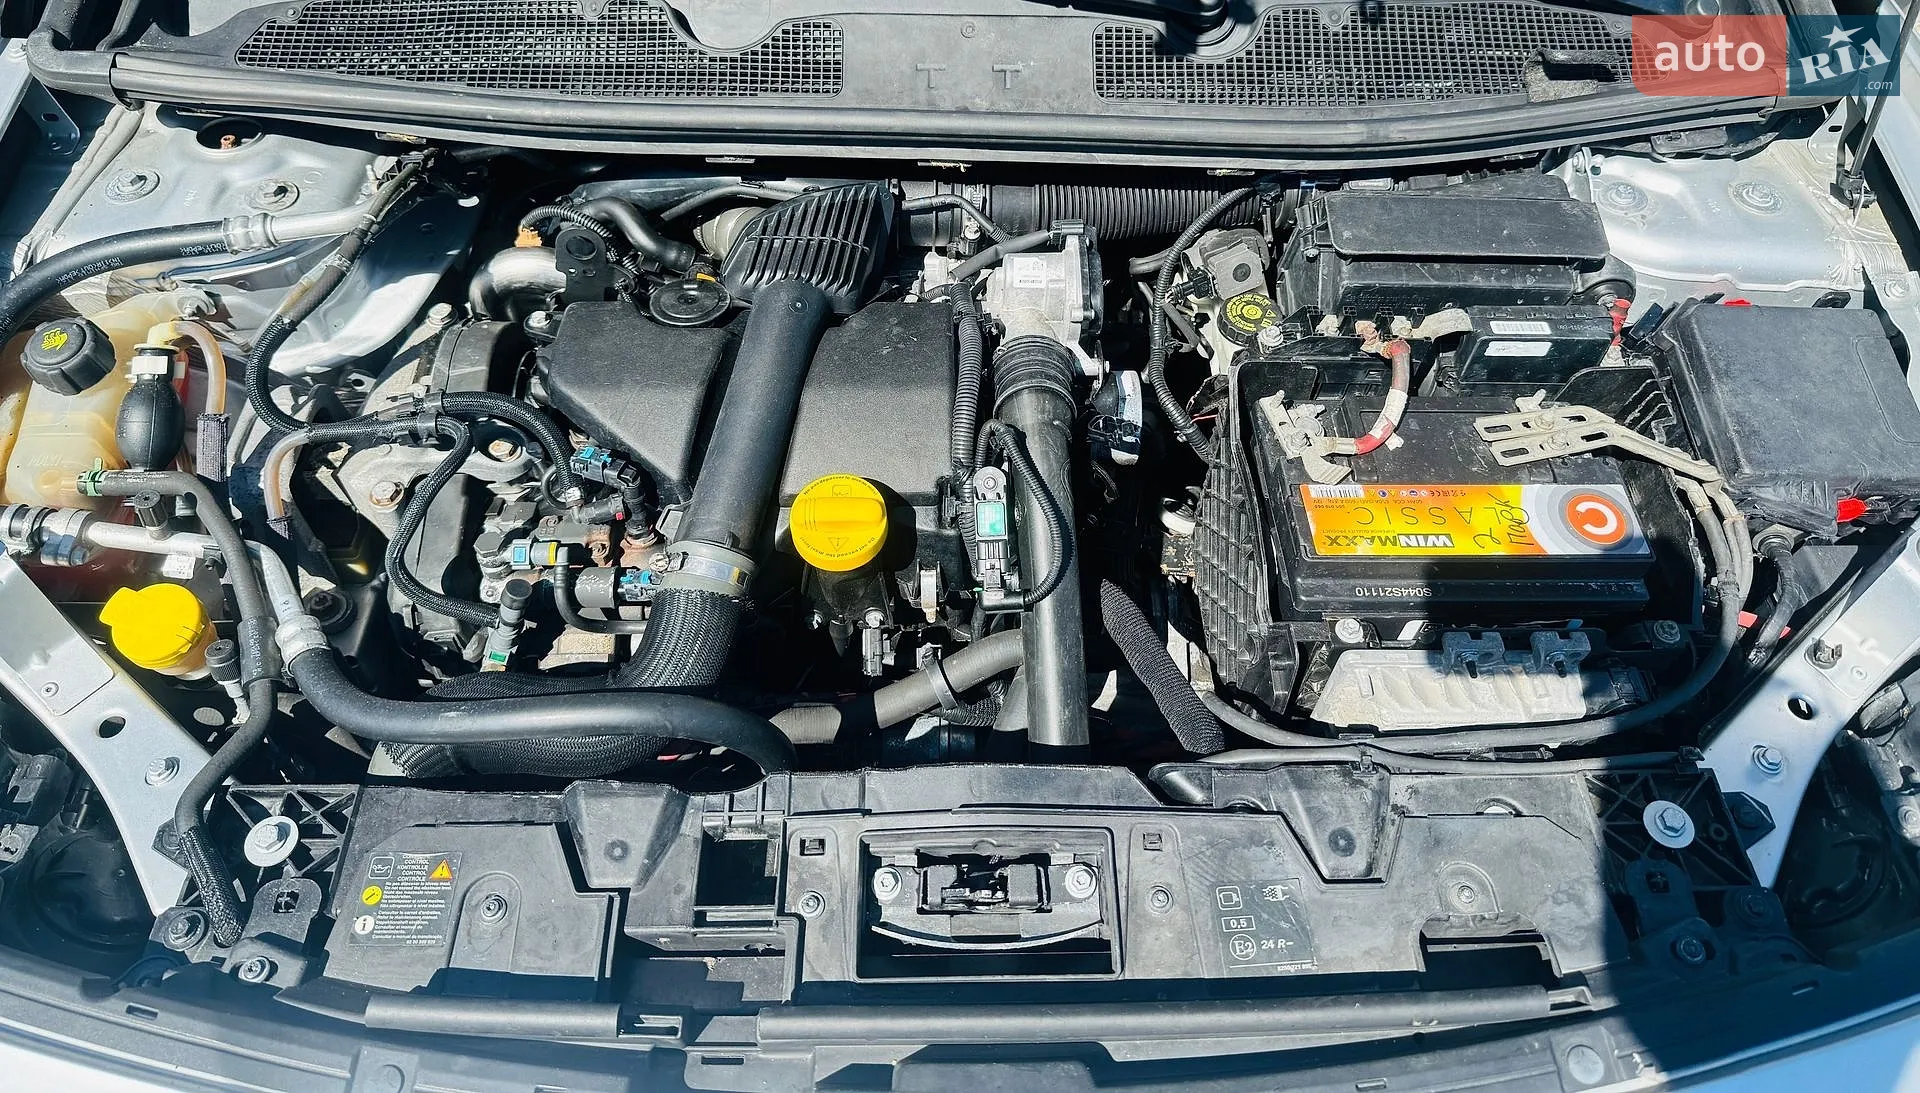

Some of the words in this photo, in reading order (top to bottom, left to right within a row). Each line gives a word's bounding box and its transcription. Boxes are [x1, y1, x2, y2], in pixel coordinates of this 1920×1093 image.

[1353, 506, 1530, 526] CLASSIC
[1575, 501, 1618, 536] C
[1324, 533, 1455, 548] WINMAXX
[1355, 587, 1432, 597] S044S21110
[1230, 919, 1248, 929] 0,5
[1261, 939, 1275, 950] 24
